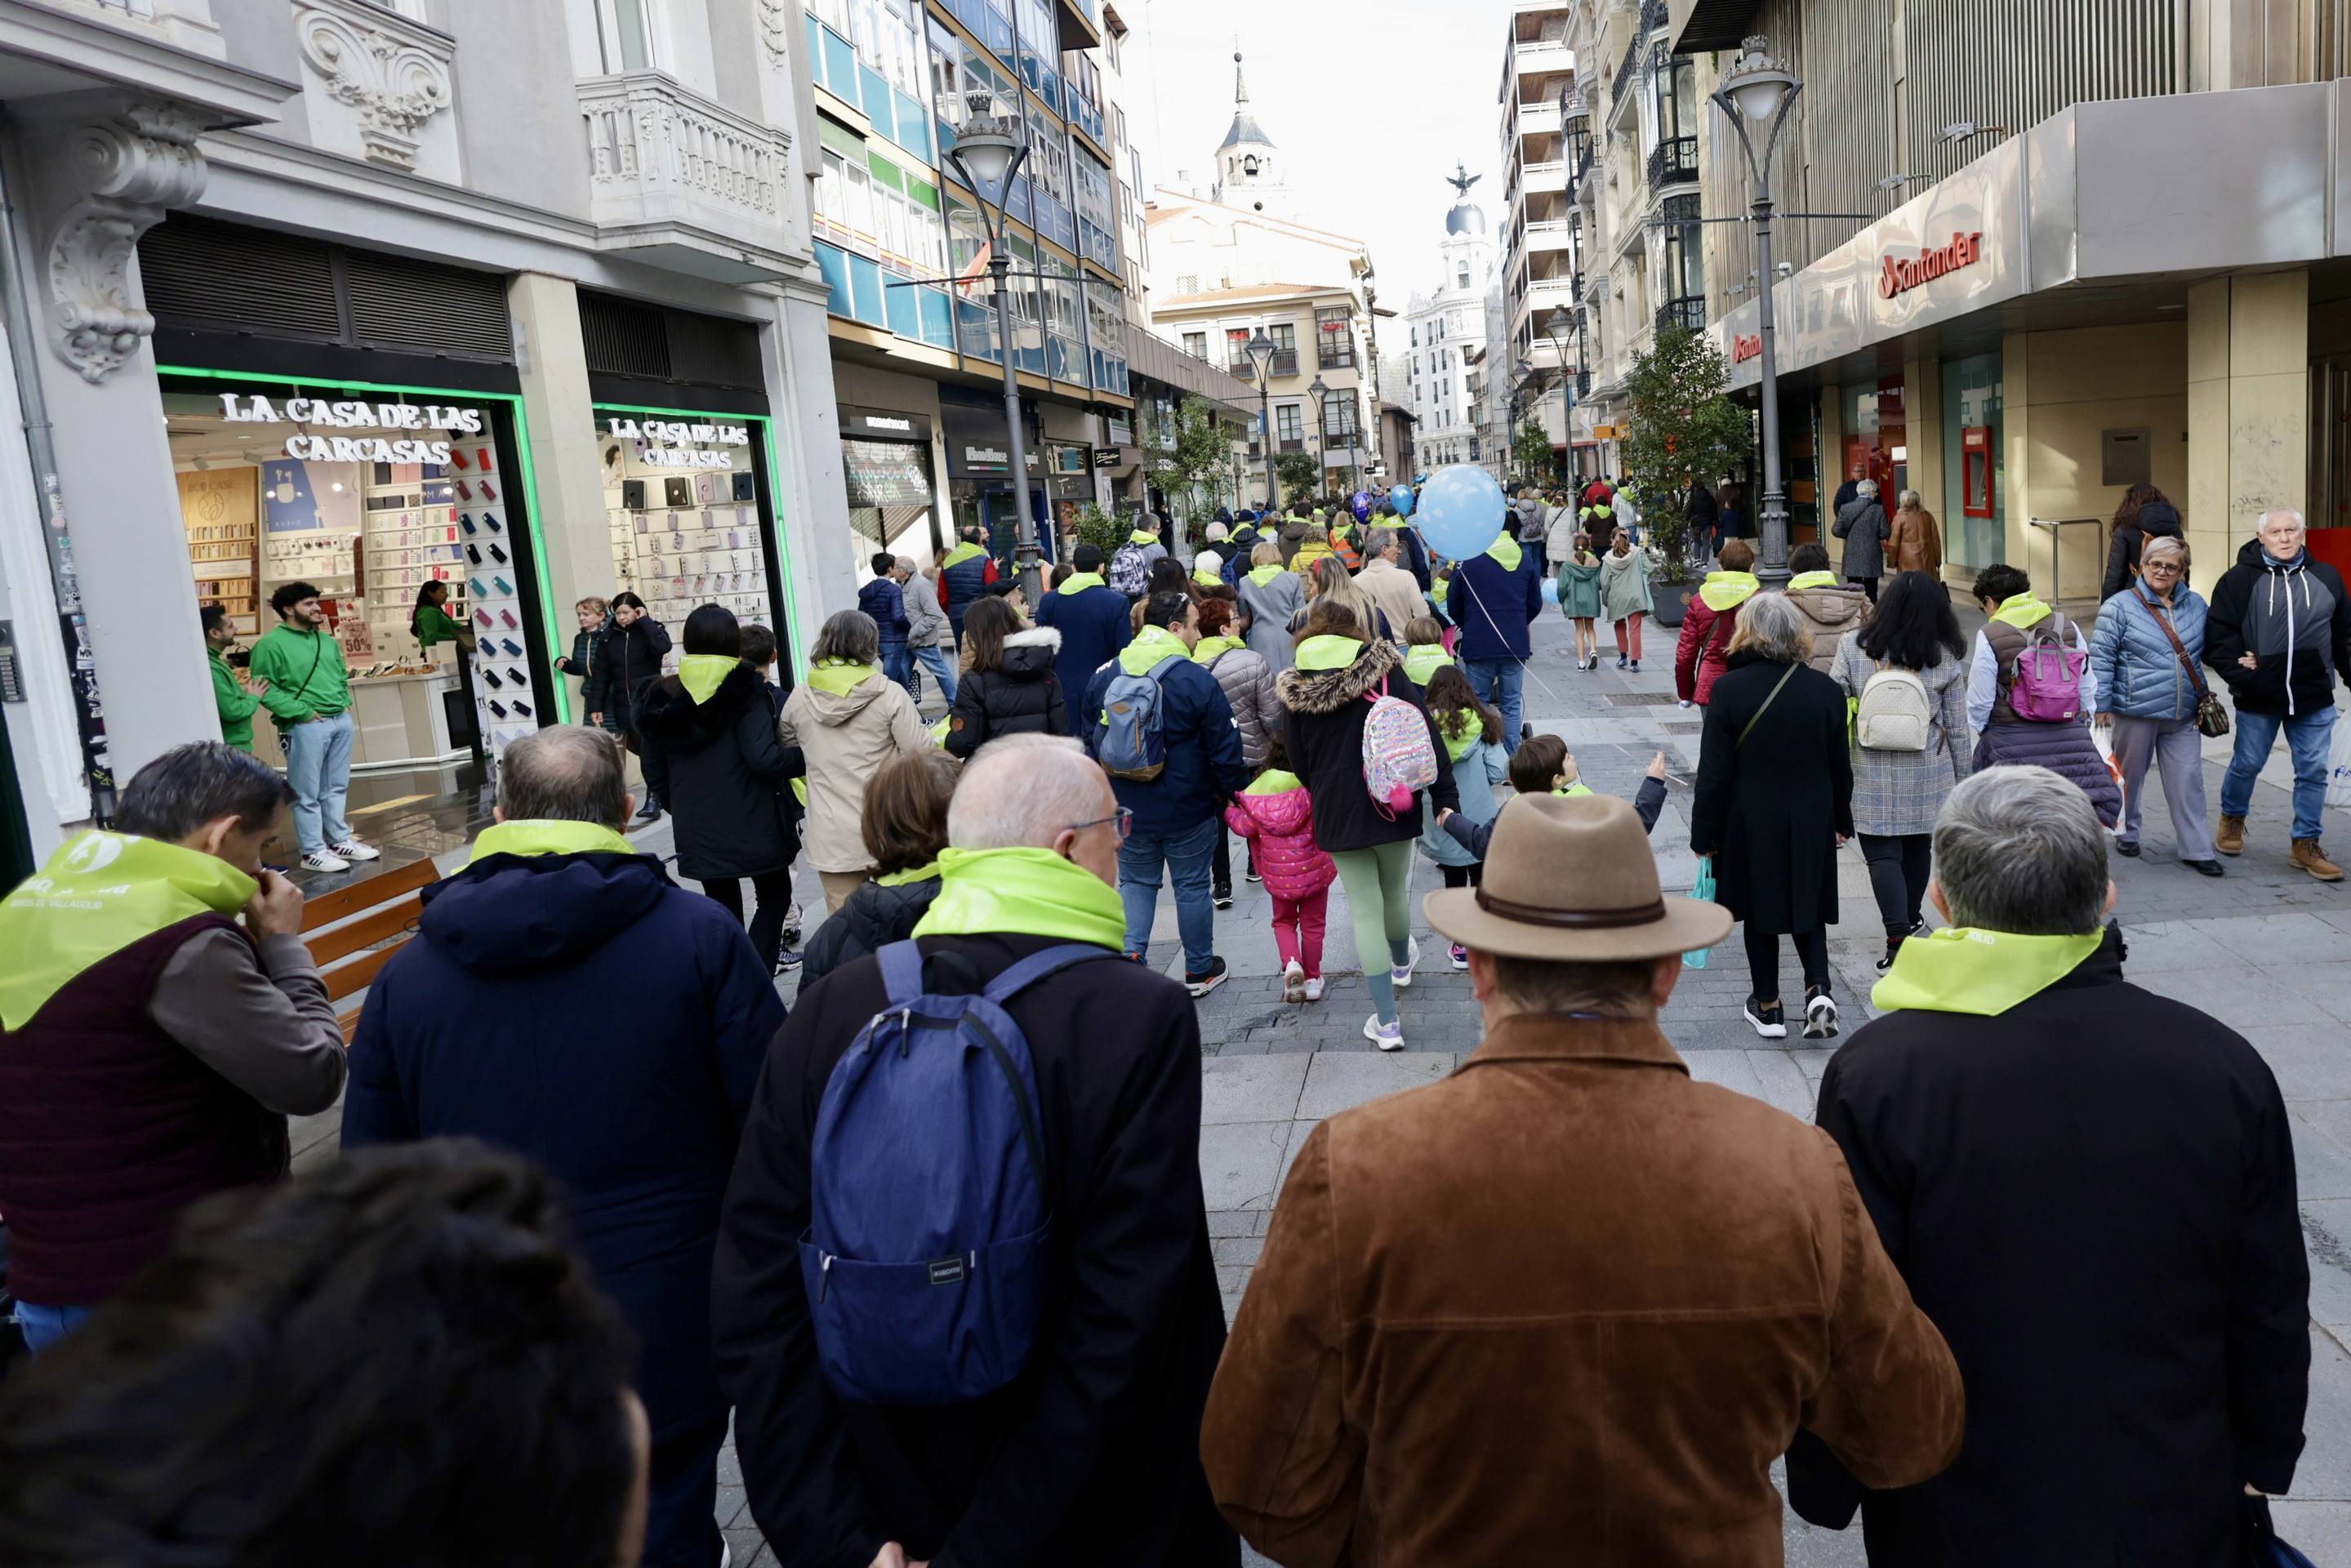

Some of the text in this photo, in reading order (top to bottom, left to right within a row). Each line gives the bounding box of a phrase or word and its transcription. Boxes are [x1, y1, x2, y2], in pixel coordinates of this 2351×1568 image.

[1895, 231, 1983, 292] Santander
[219, 393, 482, 432] LA CASA DE LAS
[608, 417, 749, 445] LA CASA DE LAS
[286, 435, 451, 465] CARCASAS
[643, 448, 732, 469] CARCASAS
[345, 637, 372, 652] 50%
